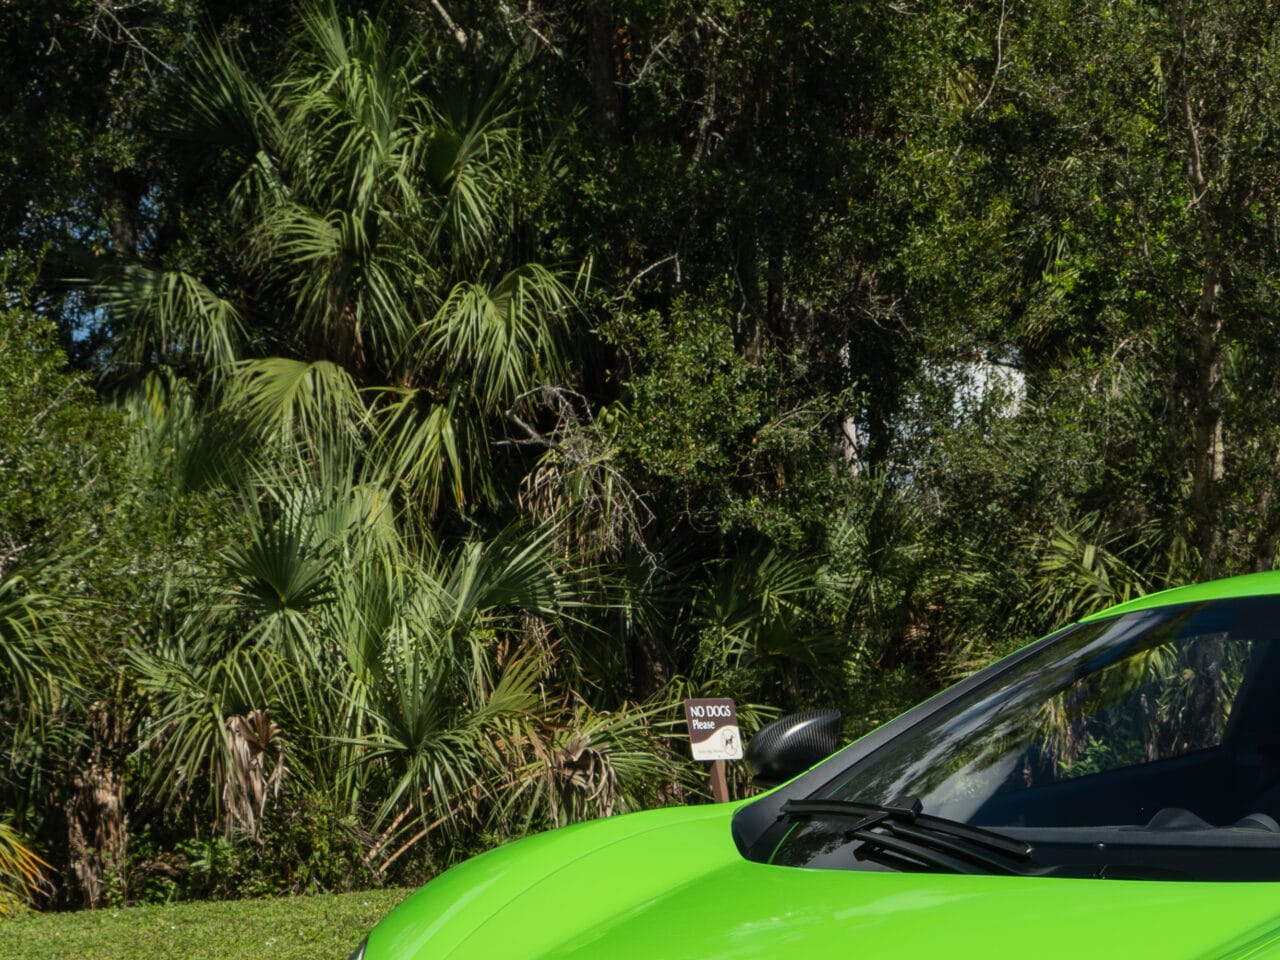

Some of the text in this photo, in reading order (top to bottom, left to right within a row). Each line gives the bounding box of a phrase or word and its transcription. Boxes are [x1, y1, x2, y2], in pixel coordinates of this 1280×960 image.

[690, 705, 731, 717] NO DOGS
[692, 719, 715, 730] Please
